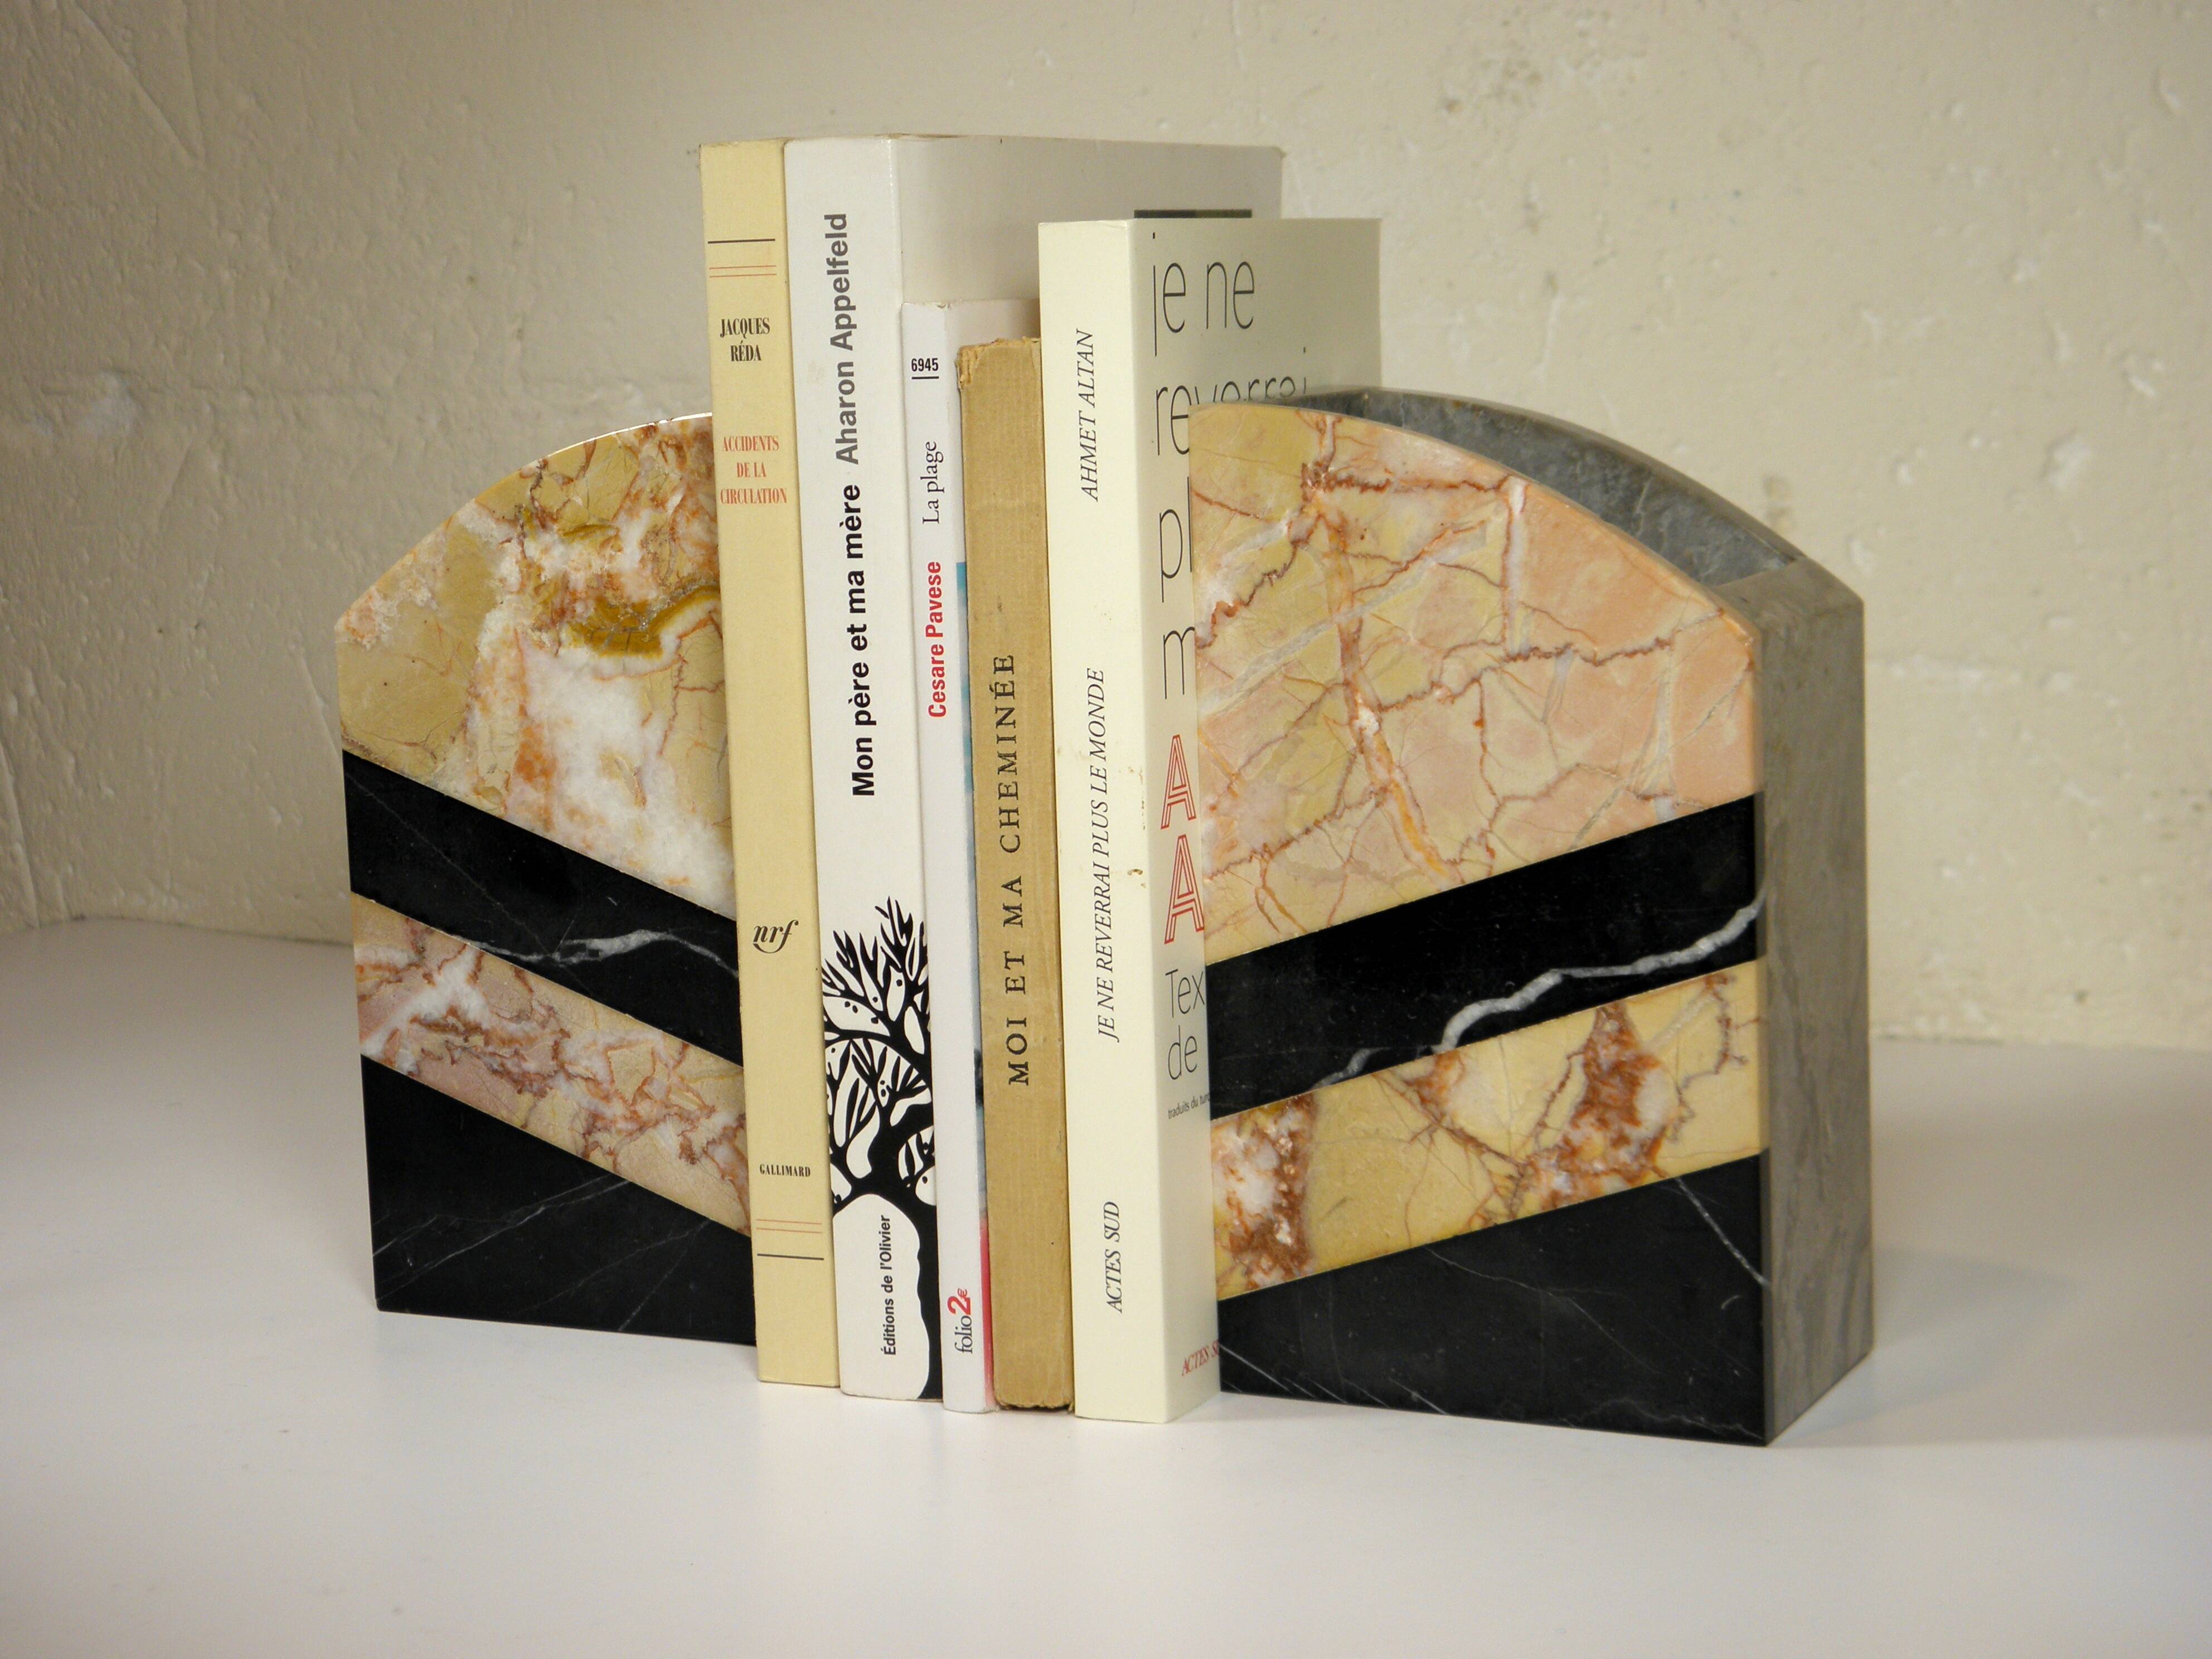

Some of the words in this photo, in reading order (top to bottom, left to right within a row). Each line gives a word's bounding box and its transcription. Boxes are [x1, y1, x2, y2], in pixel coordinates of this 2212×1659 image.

[824, 214, 857, 351] Appelfeld
[1152, 232, 1186, 357] je
[1206, 261, 1255, 329] ne
[720, 317, 770, 339] JACQUES
[730, 339, 761, 362] RÉDA
[911, 357, 939, 372] 6945
[1076, 328, 1095, 409] ALTAN
[835, 361, 858, 465] Aharon
[722, 435, 780, 452] ACCIDENTS
[920, 441, 944, 493] plage
[1078, 410, 1098, 502] AHMET
[720, 487, 788, 505] CIRCULATION
[736, 462, 751, 478] DE
[753, 462, 767, 478] LA
[840, 484, 863, 559] mère
[922, 498, 939, 525] La
[847, 570, 866, 613] ma
[925, 561, 943, 638] Pavese
[847, 623, 868, 651] et
[848, 662, 877, 725] père
[928, 644, 946, 718] Cesare
[1086, 668, 1107, 762] MONDE
[852, 737, 875, 796] Mon
[989, 654, 1021, 853] CHEMINÉE
[1090, 765, 1108, 795] LE
[1090, 799, 1109, 858] PLUS
[1001, 875, 1023, 928] MA
[1093, 861, 1113, 973] REVERRAI
[753, 919, 799, 954] nrf
[1004, 950, 1026, 995] ET
[1097, 977, 1114, 1012] NE
[1006, 1017, 1029, 1086] MOI
[1098, 1015, 1120, 1043] JE
[1168, 1025, 1197, 1080] de
[1191, 1095, 1199, 1109] du
[759, 1163, 811, 1177] GALLIMARD
[879, 1214, 892, 1270] l'Olivier
[1103, 1201, 1120, 1243] SUD
[881, 1275, 894, 1293] de
[1104, 1249, 1123, 1314] ACTES
[880, 1298, 896, 1355] Éditions
[1181, 1345, 1210, 1376] ACTES
